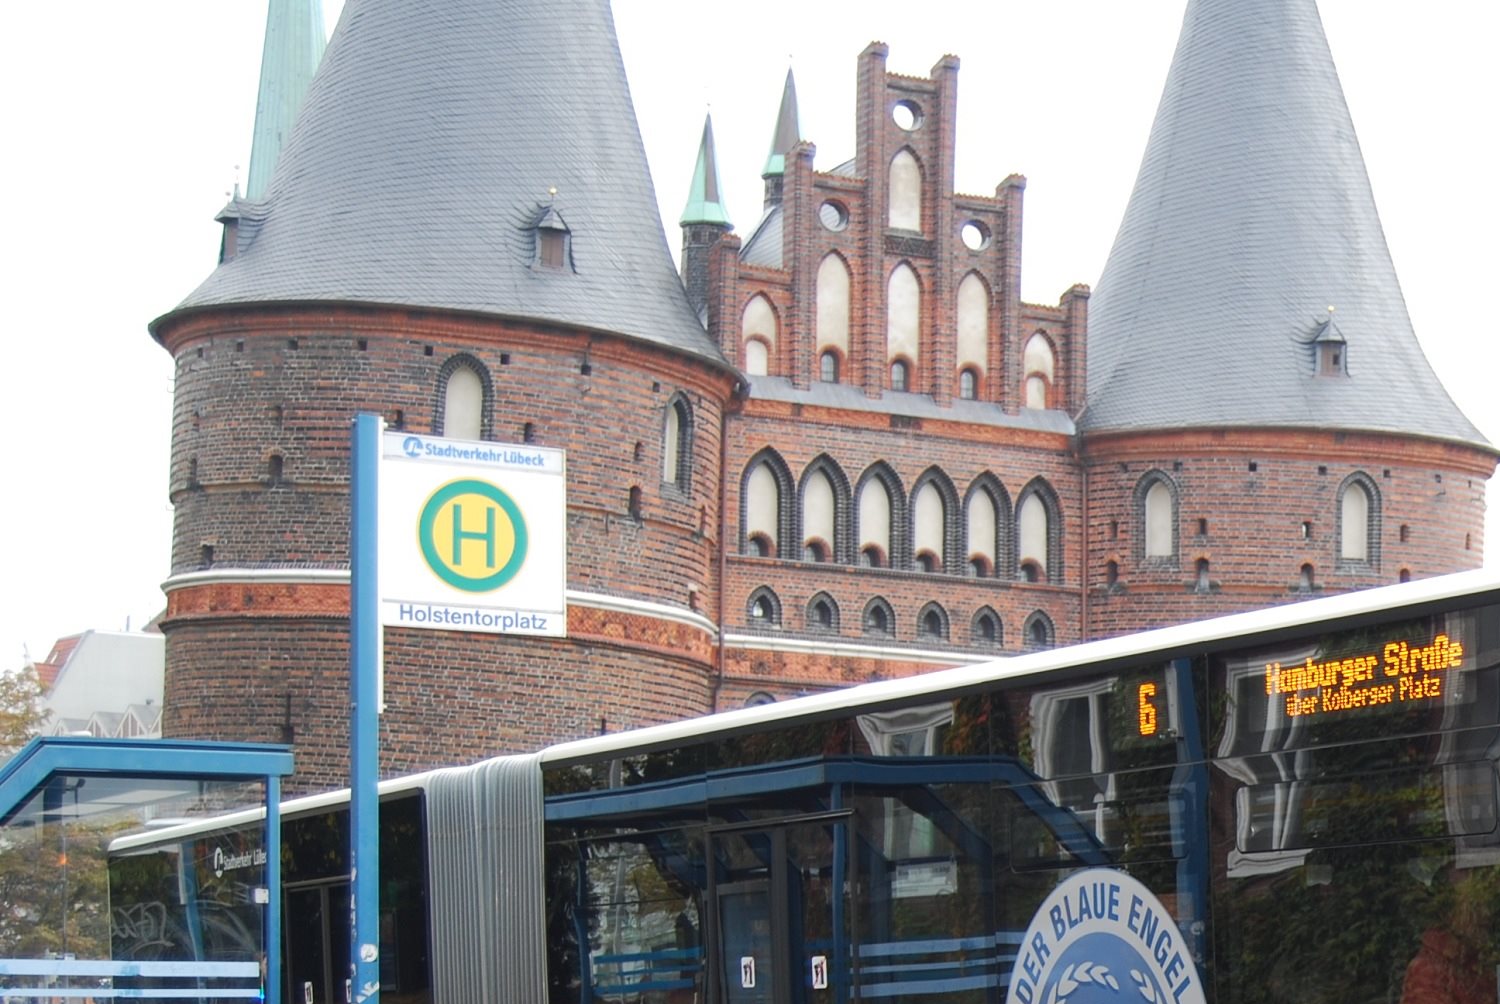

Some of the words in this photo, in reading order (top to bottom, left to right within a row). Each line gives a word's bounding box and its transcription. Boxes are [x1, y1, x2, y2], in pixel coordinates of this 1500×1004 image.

[424, 442, 502, 462] Stadtverkehr
[503, 452, 545, 467] Lübeck
[452, 503, 496, 569] H
[399, 604, 548, 631] Holstentorplatz
[1265, 656, 1378, 695] Hamburger
[1384, 633, 1463, 677] Straße
[1138, 682, 1157, 736] 6
[1286, 694, 1318, 717] über
[1322, 685, 1395, 712] Kolberger
[1399, 674, 1440, 701] Platz
[1049, 882, 1120, 941] BLAUE
